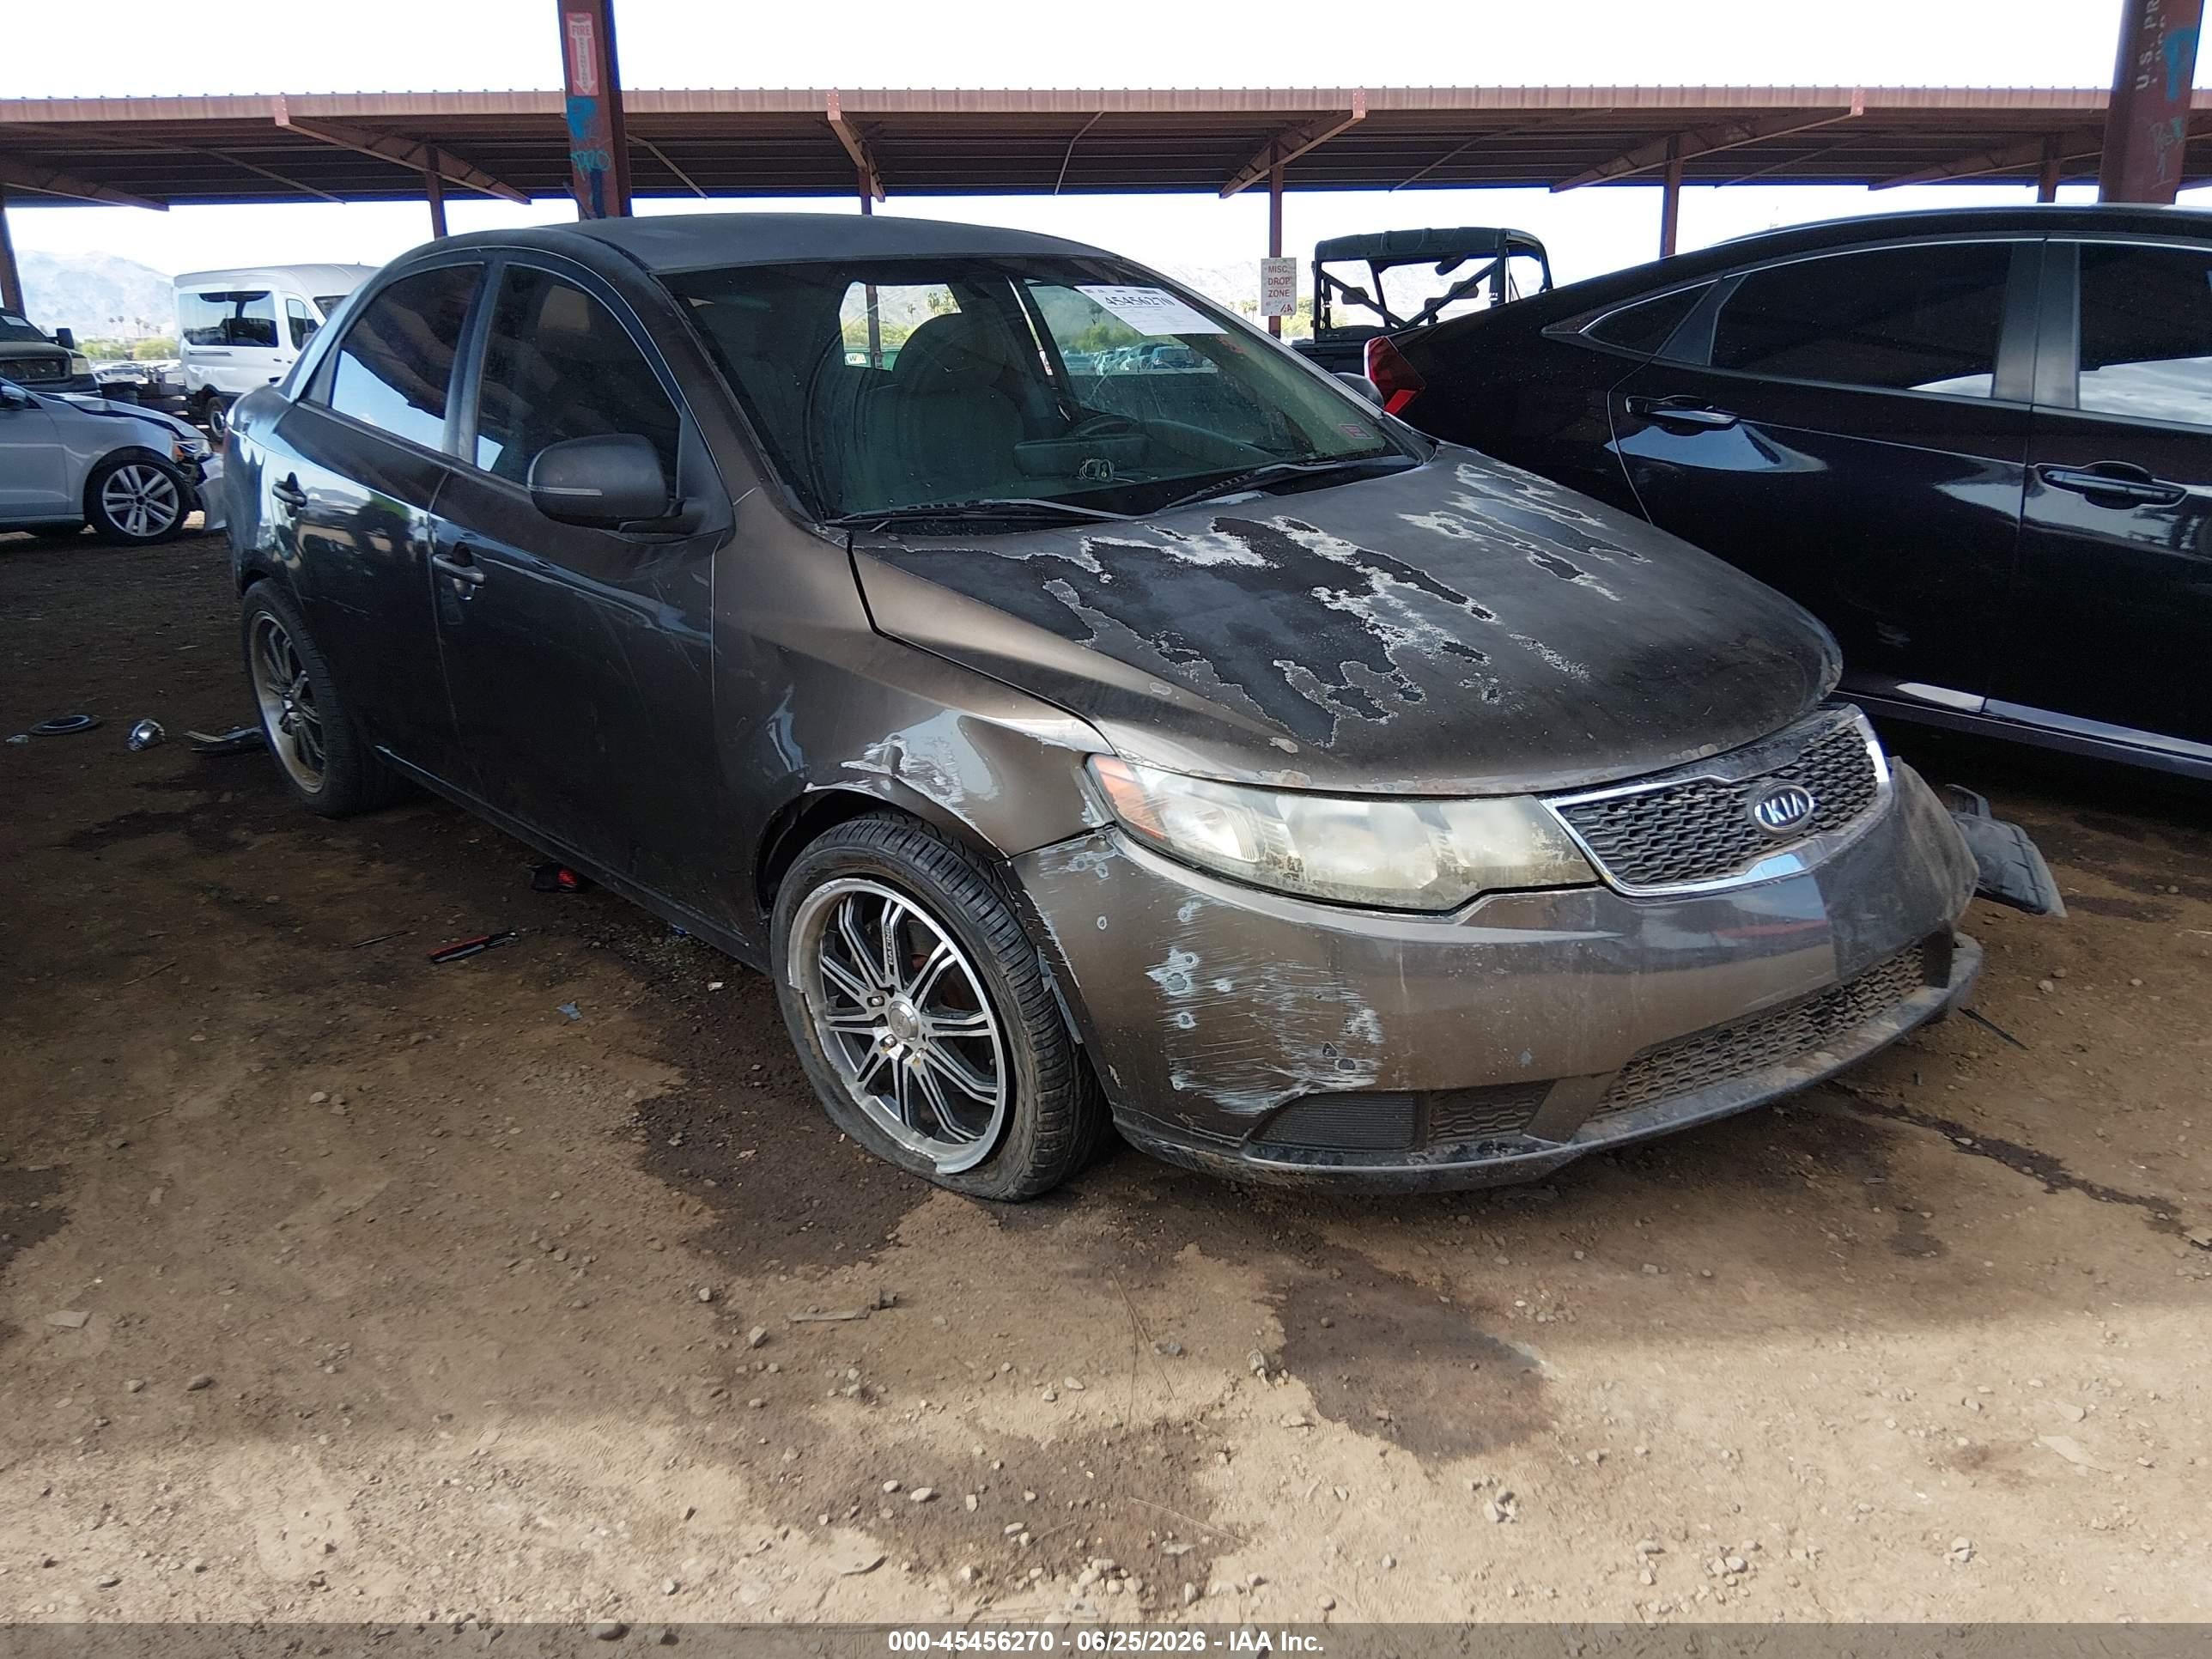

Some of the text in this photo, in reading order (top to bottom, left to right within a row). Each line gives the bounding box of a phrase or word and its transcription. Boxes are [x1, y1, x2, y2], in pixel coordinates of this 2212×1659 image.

[572, 25, 591, 36] FIRE
[1268, 265, 1290, 274] MISC.
[1268, 276, 1291, 286] DROP
[1268, 289, 1291, 298] ZONE
[1763, 792, 1808, 823] KIA
